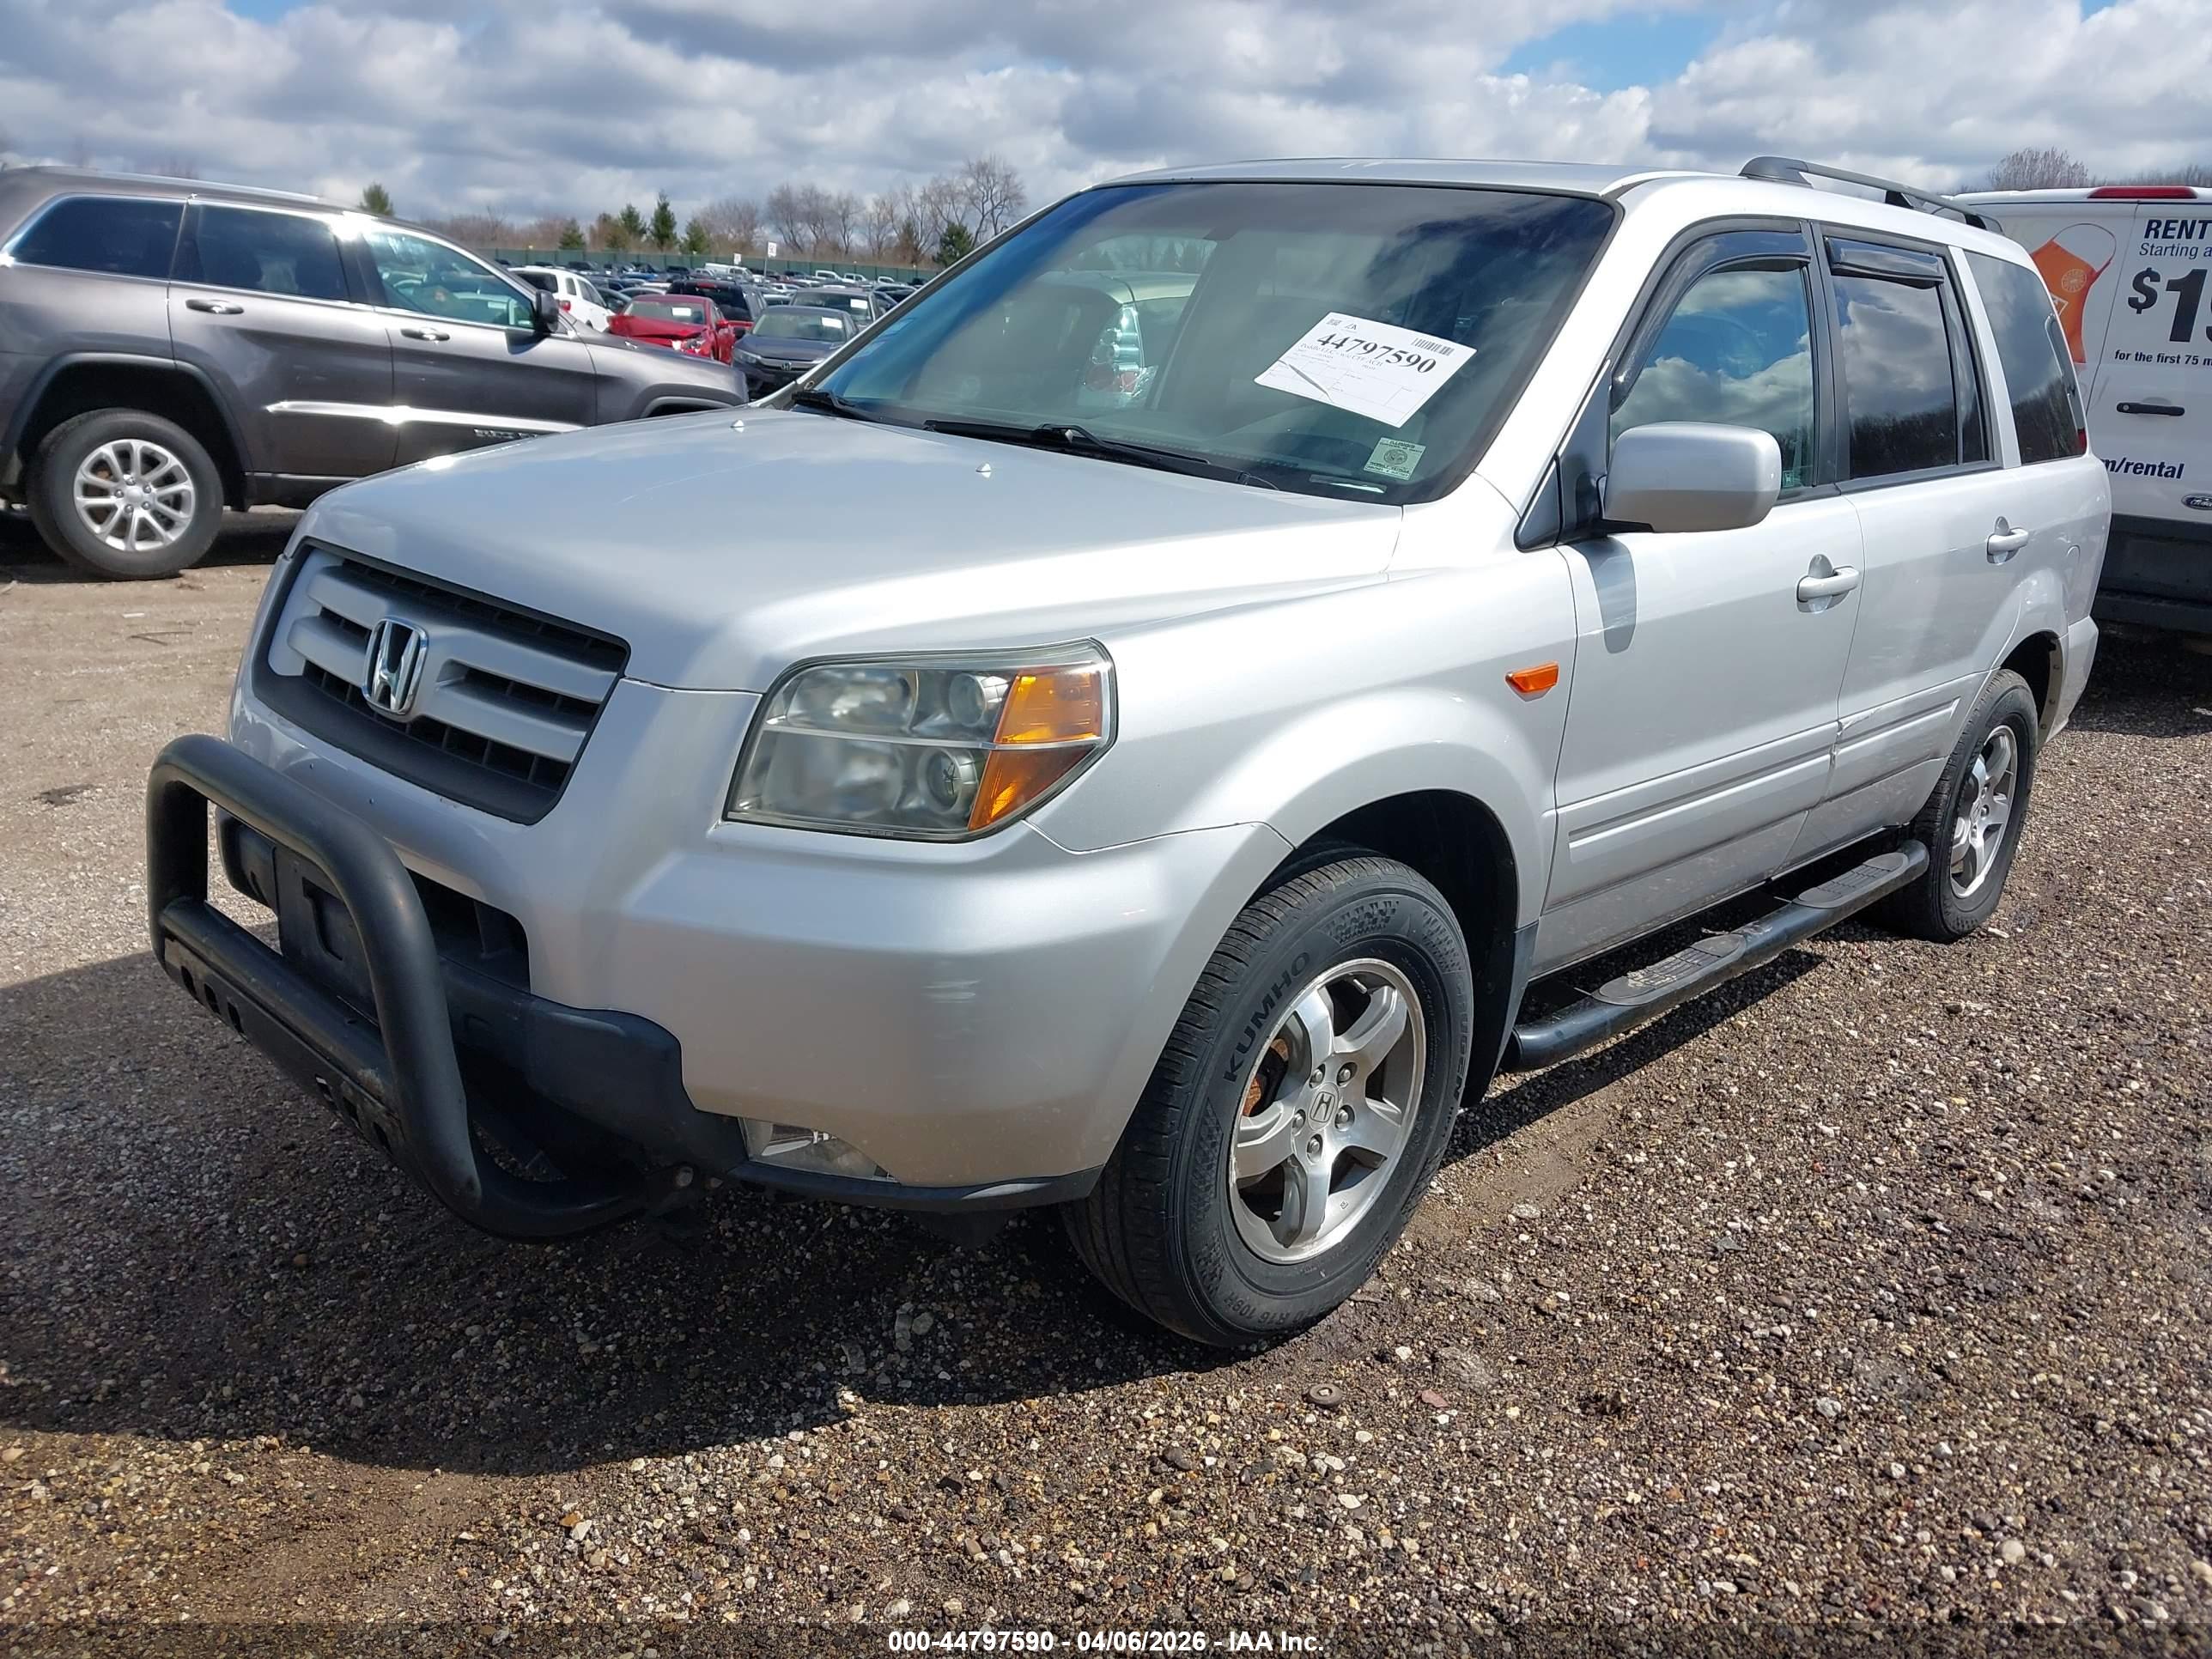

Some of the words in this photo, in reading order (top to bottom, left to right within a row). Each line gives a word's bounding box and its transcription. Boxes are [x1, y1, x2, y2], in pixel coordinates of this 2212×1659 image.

[2144, 219, 2212, 240] RENT
[2139, 242, 2199, 260] Starting
[2127, 267, 2212, 343] $1
[1317, 333, 1437, 374] 44797590
[2114, 349, 2131, 361] for
[2135, 351, 2153, 362] the
[2156, 353, 2181, 364] first
[2185, 355, 2199, 366] 75
[1223, 951, 1310, 1082] KUMHO
